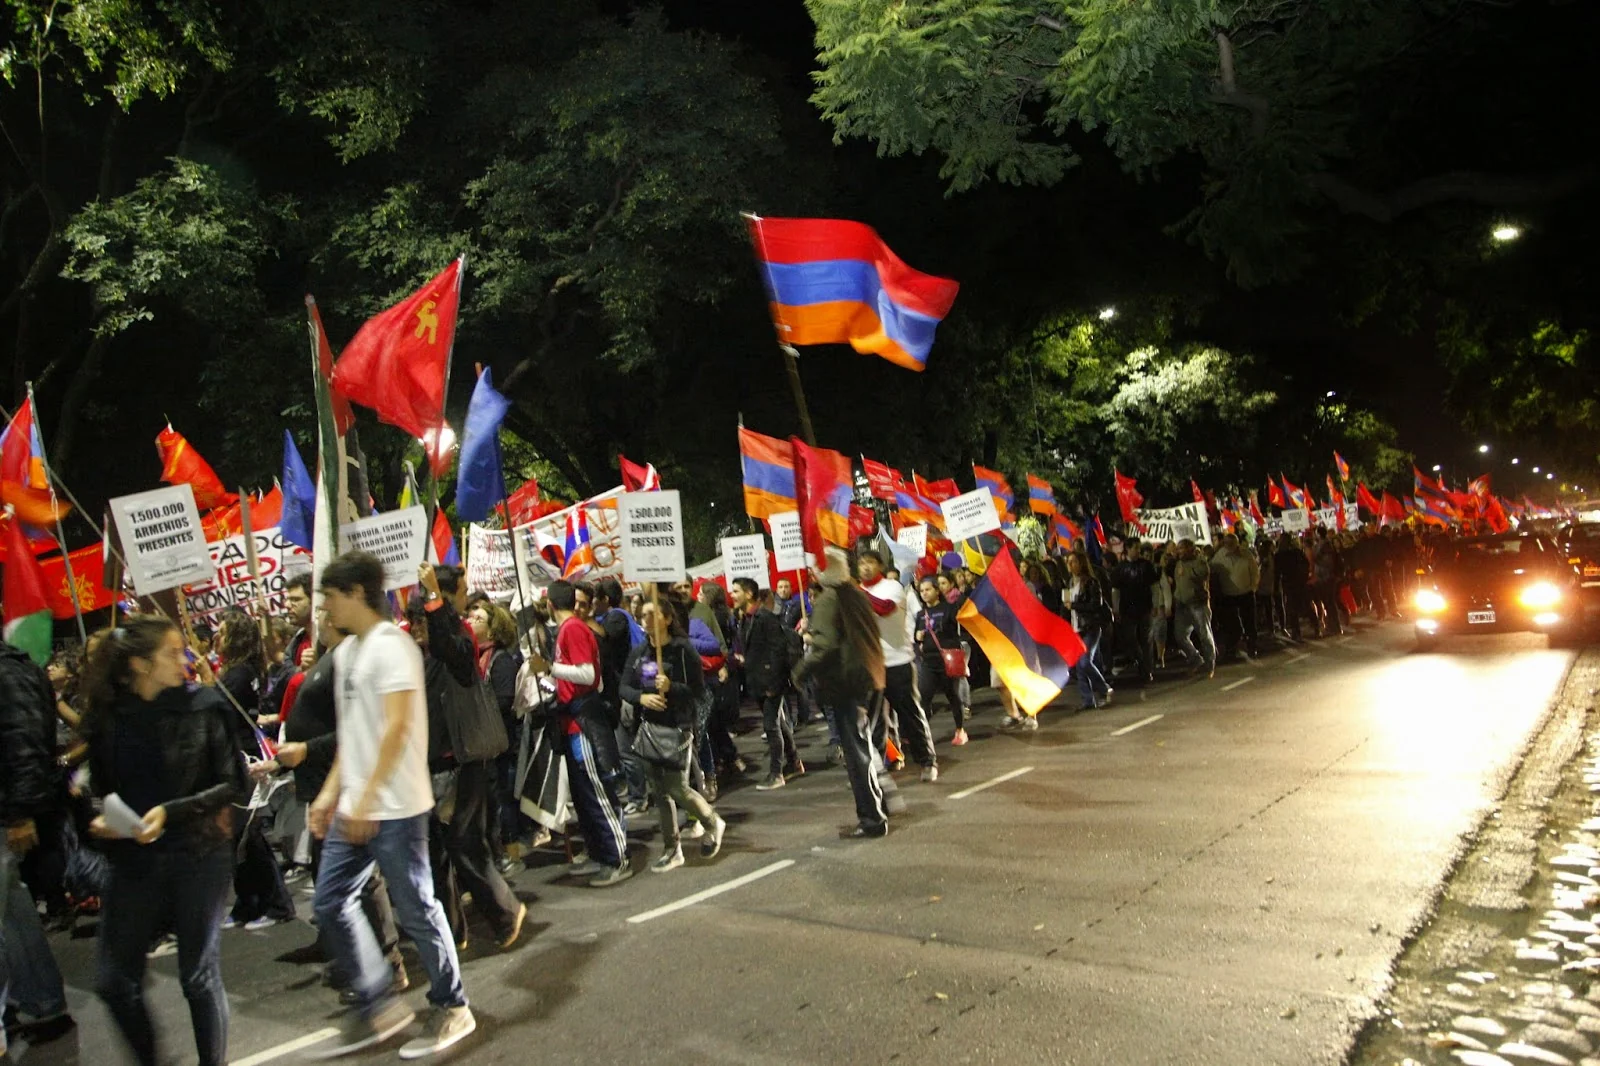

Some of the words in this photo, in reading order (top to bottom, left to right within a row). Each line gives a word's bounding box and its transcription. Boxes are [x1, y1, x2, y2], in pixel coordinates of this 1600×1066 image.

[130, 502, 185, 524] 1.500.000
[628, 506, 672, 518] 1.500.000
[134, 516, 190, 539] ARMENIOS
[382, 522, 406, 532] ISRAEL
[630, 522, 674, 533] ARMENIOS
[138, 531, 194, 554] PRESENTES
[352, 538, 384, 549] ESTADOS
[386, 530, 414, 542] UNIDOS
[632, 536, 676, 548] PRESENTES
[367, 544, 403, 556] NOCIDAS
[404, 541, 408, 550] Y
[378, 552, 409, 564] ADORES
